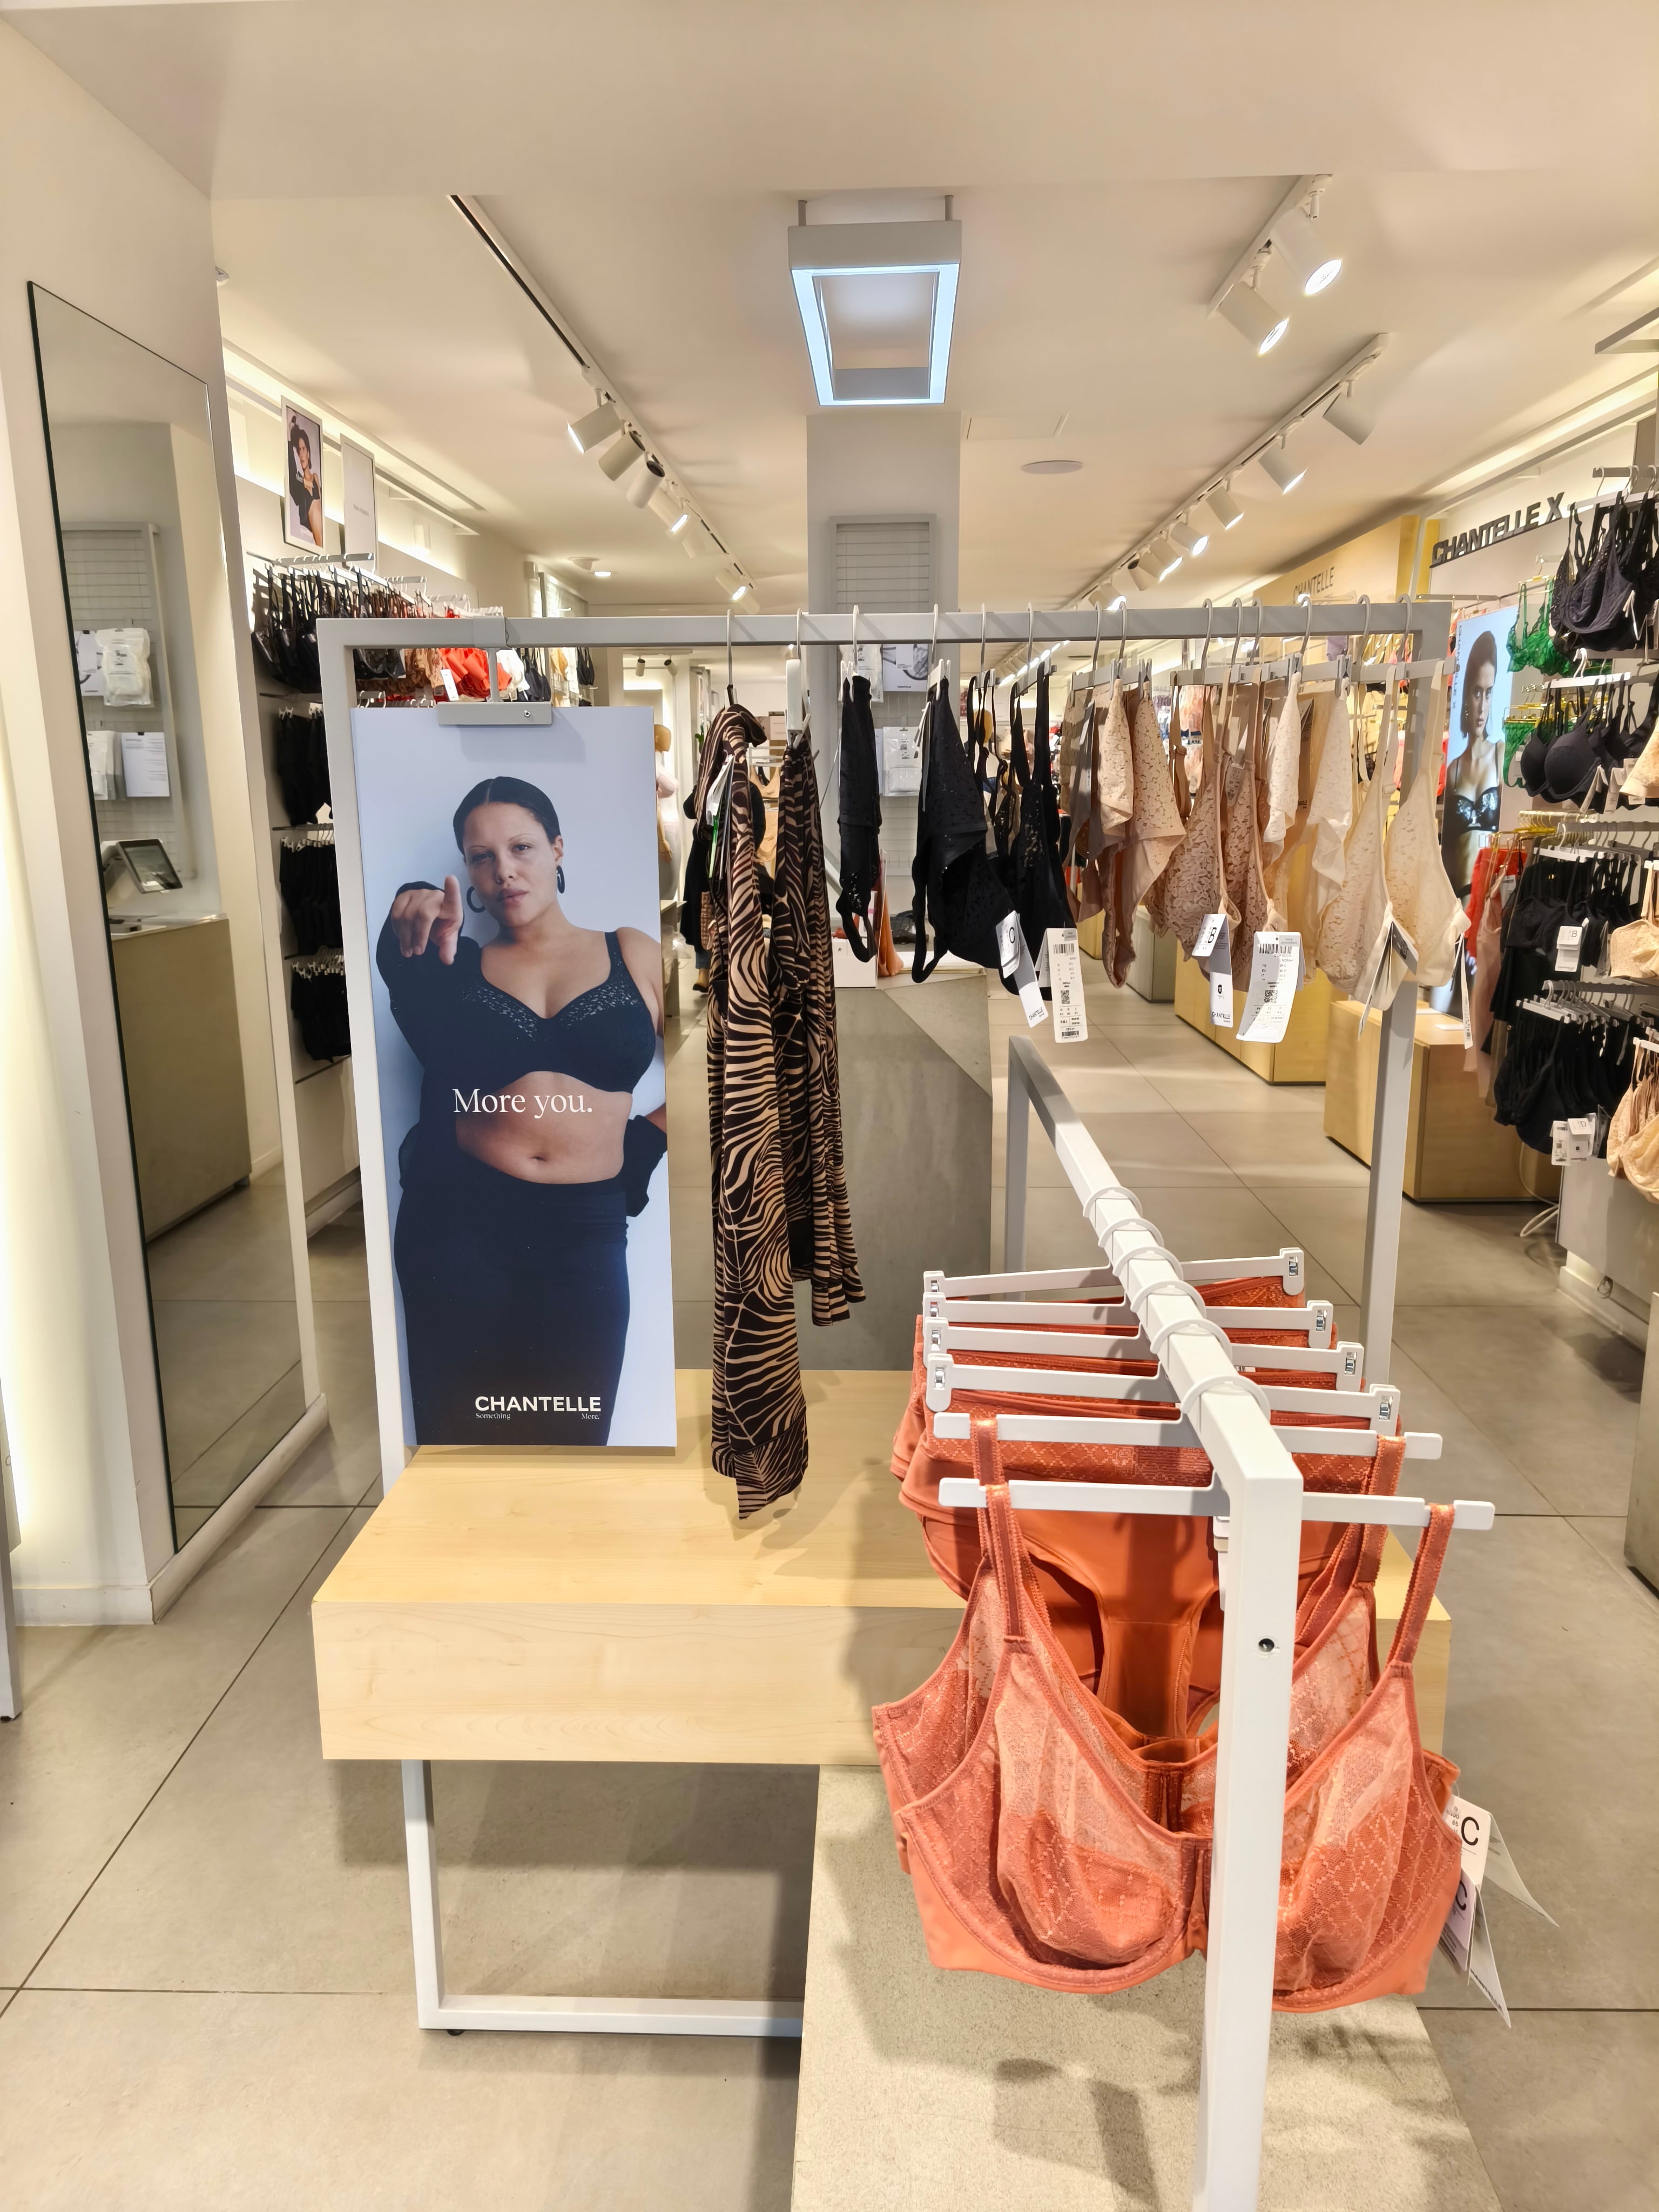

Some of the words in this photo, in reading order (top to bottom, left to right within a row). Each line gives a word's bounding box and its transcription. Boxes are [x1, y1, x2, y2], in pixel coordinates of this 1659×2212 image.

[1432, 502, 1541, 565] CHANTELLE
[1546, 491, 1565, 523] X
[1009, 926, 1015, 944] C
[1208, 927, 1217, 944] B
[1212, 1011, 1231, 1020] CHANTELLE
[451, 1089, 526, 1113] More
[533, 1095, 592, 1119] you.
[475, 1395, 601, 1412] CHANTELLE
[1461, 1816, 1480, 1846] C
